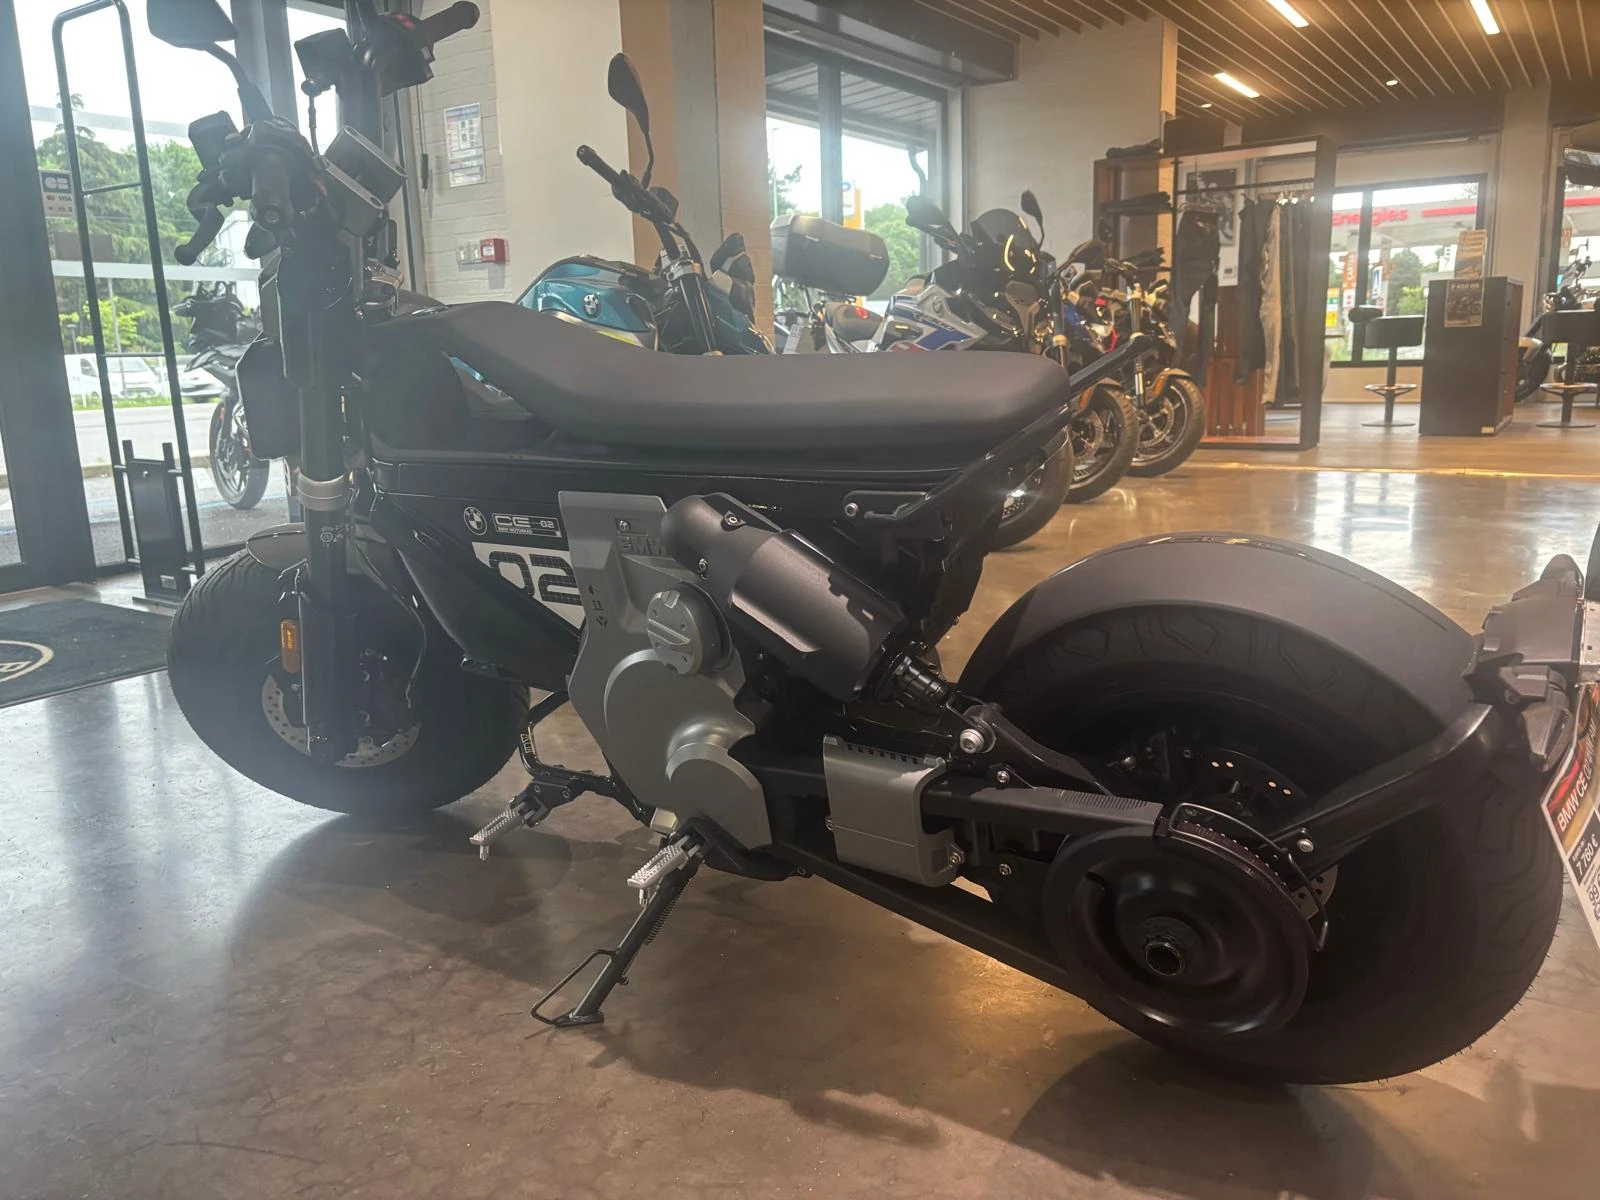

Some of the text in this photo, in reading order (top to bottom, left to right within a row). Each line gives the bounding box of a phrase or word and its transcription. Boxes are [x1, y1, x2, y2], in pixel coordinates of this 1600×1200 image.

[494, 515, 556, 529] CE 02
[488, 550, 581, 606] 02
[1557, 788, 1580, 831] BMW
[1576, 771, 1588, 799] CE
